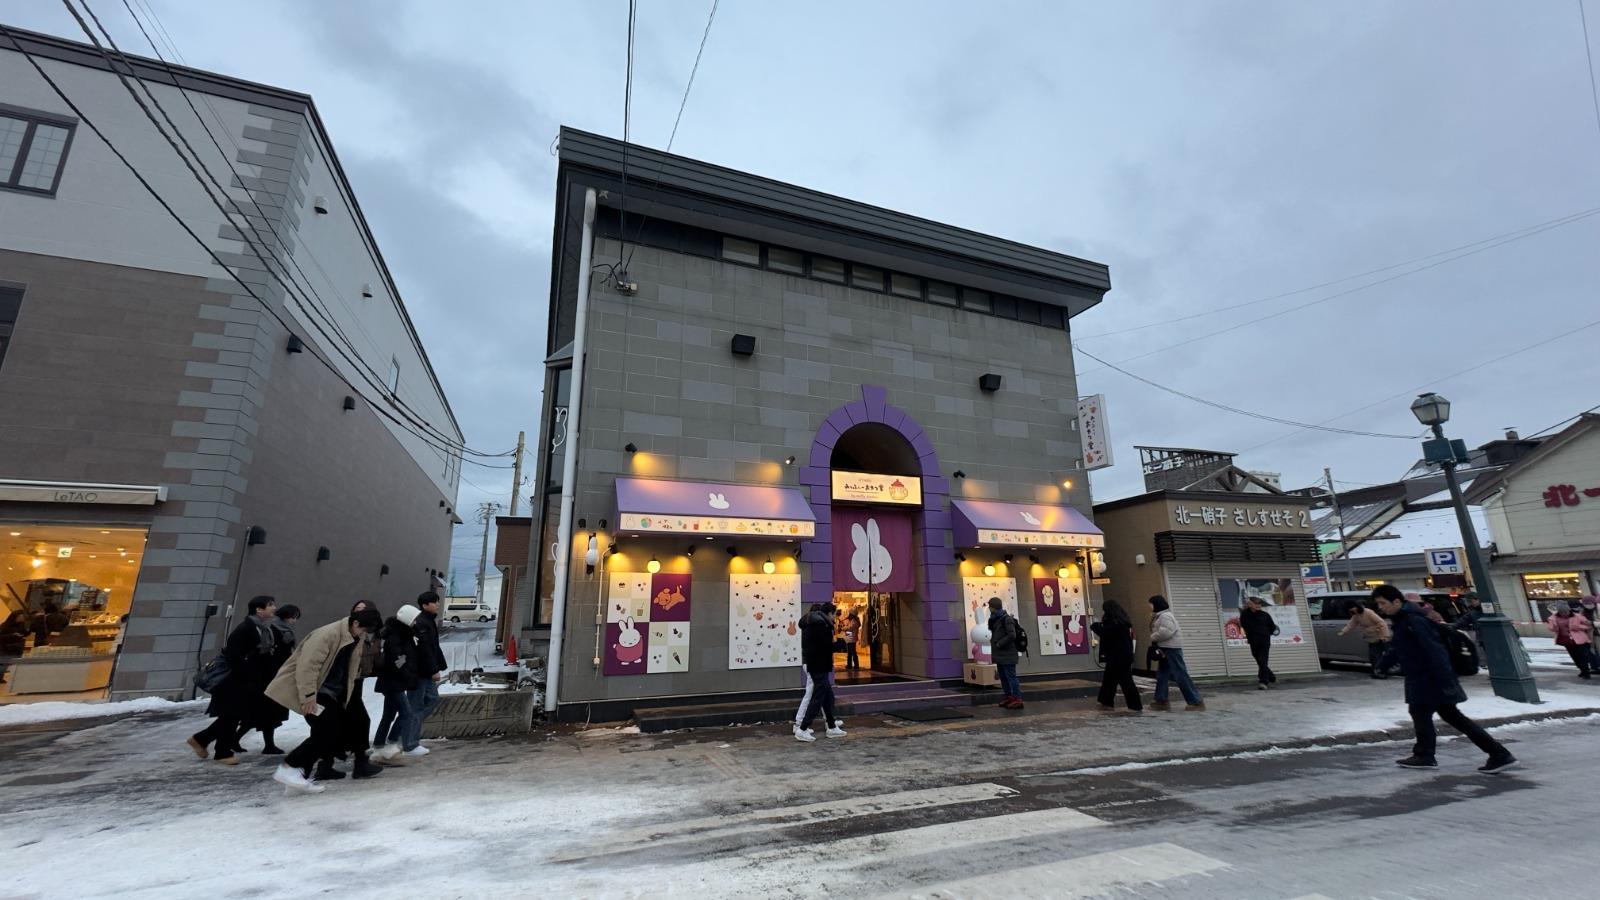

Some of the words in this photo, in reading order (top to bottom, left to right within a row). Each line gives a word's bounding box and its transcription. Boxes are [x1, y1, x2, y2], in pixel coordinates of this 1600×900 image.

[54, 492, 98, 502] LeTAO
[1175, 505, 1228, 525] 北一硝子
[1233, 508, 1293, 527] さしすせそ
[1298, 510, 1309, 528] 2
[1434, 552, 1453, 565] P
[1301, 566, 1311, 578] P
